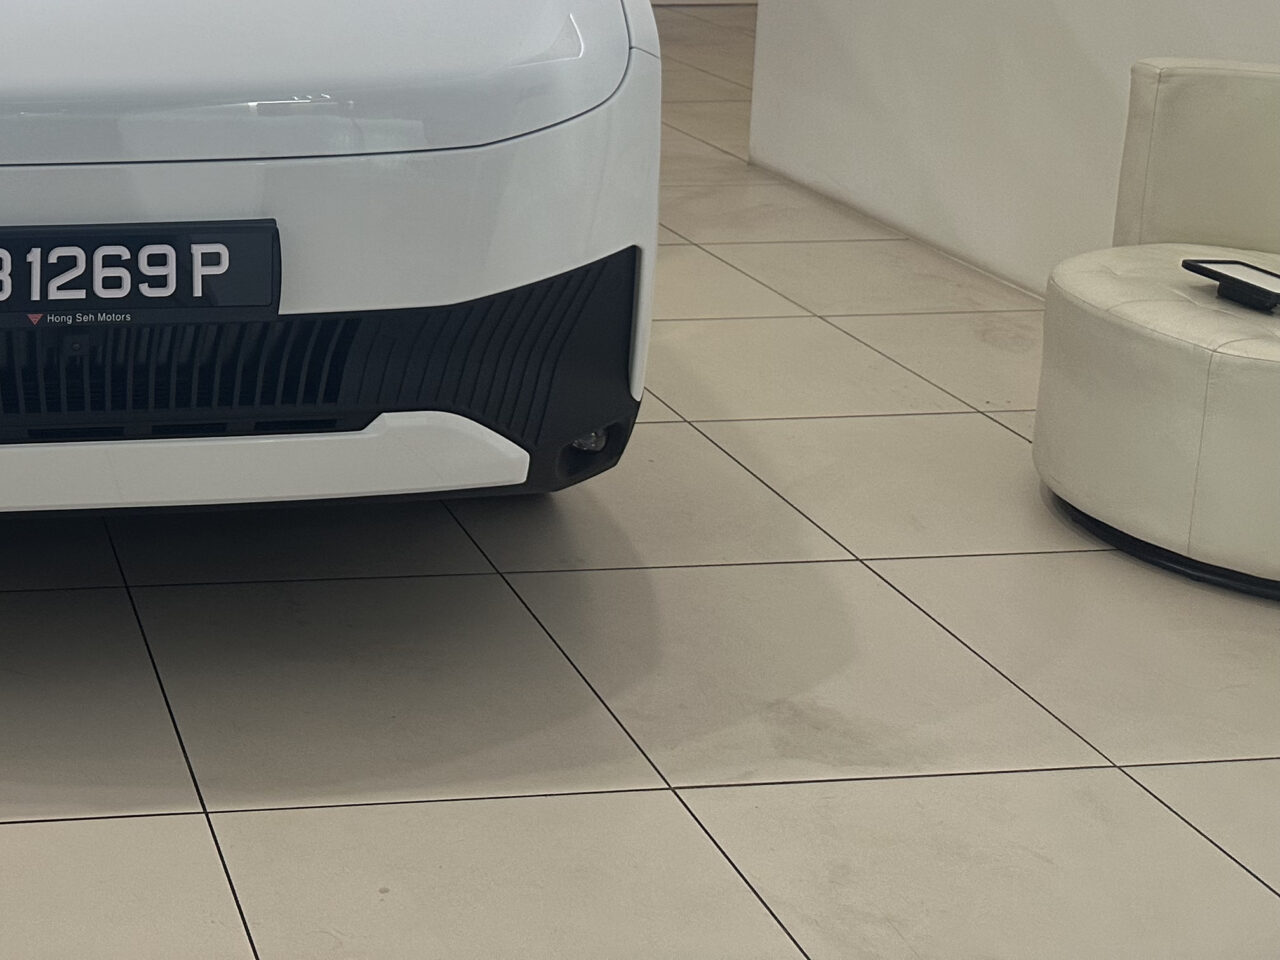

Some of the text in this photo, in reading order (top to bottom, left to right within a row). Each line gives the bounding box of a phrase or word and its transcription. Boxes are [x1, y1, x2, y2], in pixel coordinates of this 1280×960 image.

[47, 312, 132, 325] Hong Seh Motors
